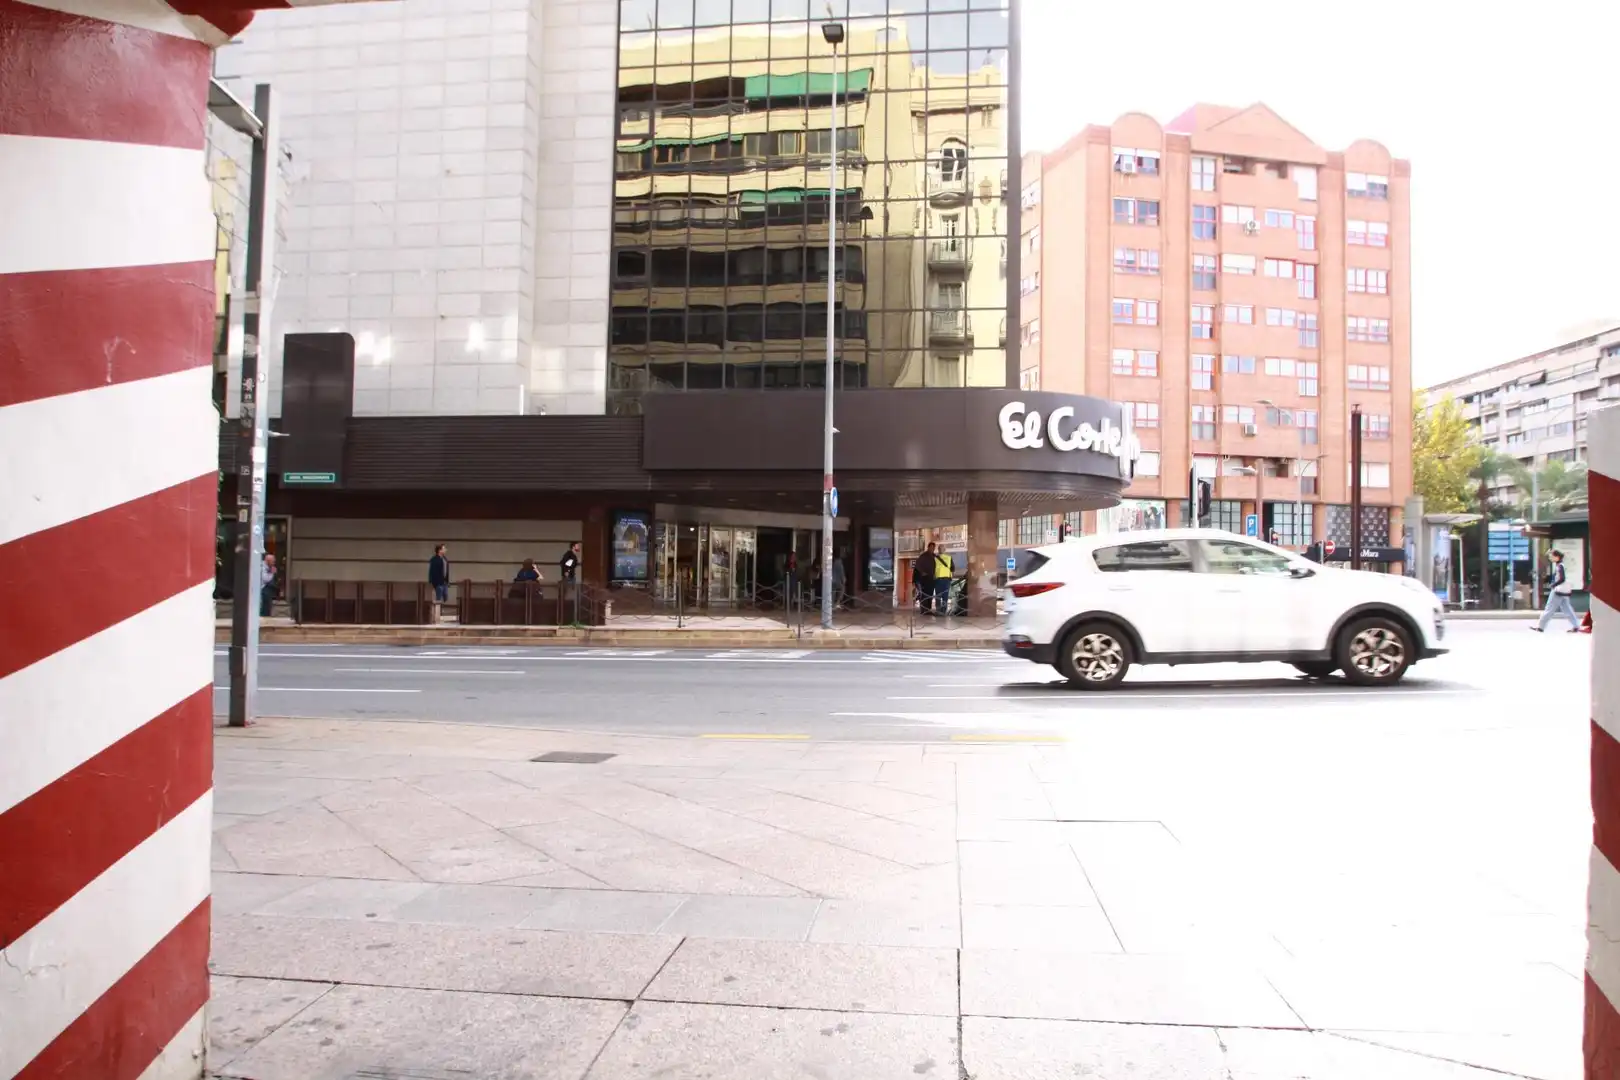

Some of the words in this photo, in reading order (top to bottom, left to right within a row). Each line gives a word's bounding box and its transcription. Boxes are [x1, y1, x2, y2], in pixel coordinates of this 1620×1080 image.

[999, 401, 1043, 449] El
[1047, 406, 1122, 457] Corte
[1248, 518, 1255, 528] P
